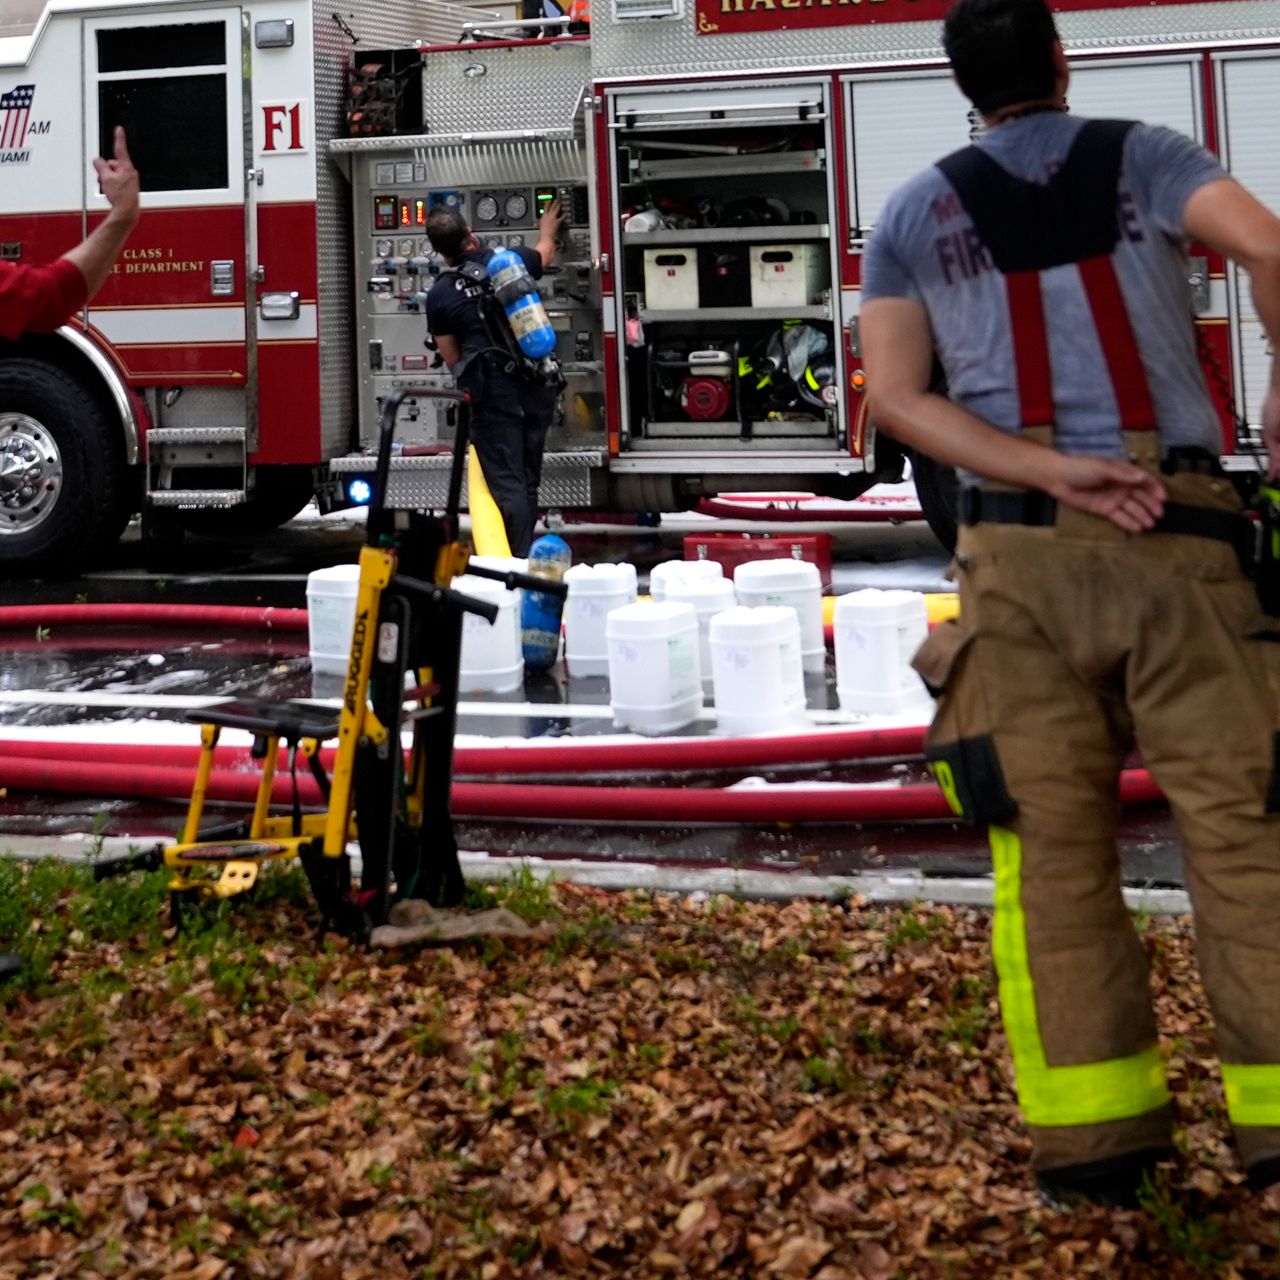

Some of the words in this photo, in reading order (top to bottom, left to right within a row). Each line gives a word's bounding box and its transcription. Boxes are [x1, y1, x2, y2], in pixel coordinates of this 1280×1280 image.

[261, 102, 305, 151] F1
[123, 247, 162, 259] CLASS
[125, 261, 205, 273] DEPARTMENT
